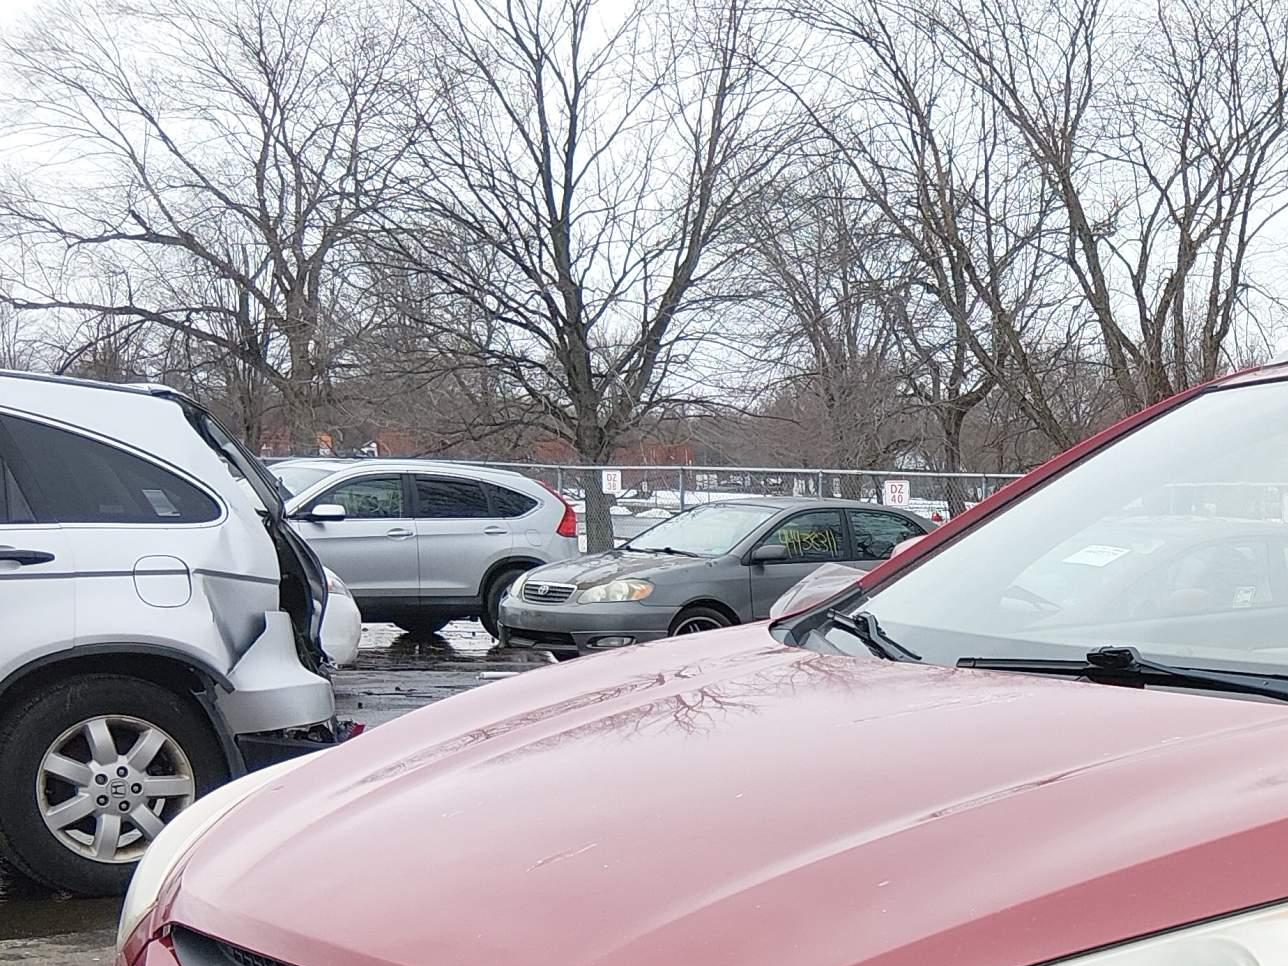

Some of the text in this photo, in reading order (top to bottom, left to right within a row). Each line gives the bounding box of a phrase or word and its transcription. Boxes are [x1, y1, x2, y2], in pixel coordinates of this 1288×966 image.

[606, 473, 617, 482] DZ
[890, 484, 904, 494] DZ
[890, 494, 904, 504] 40
